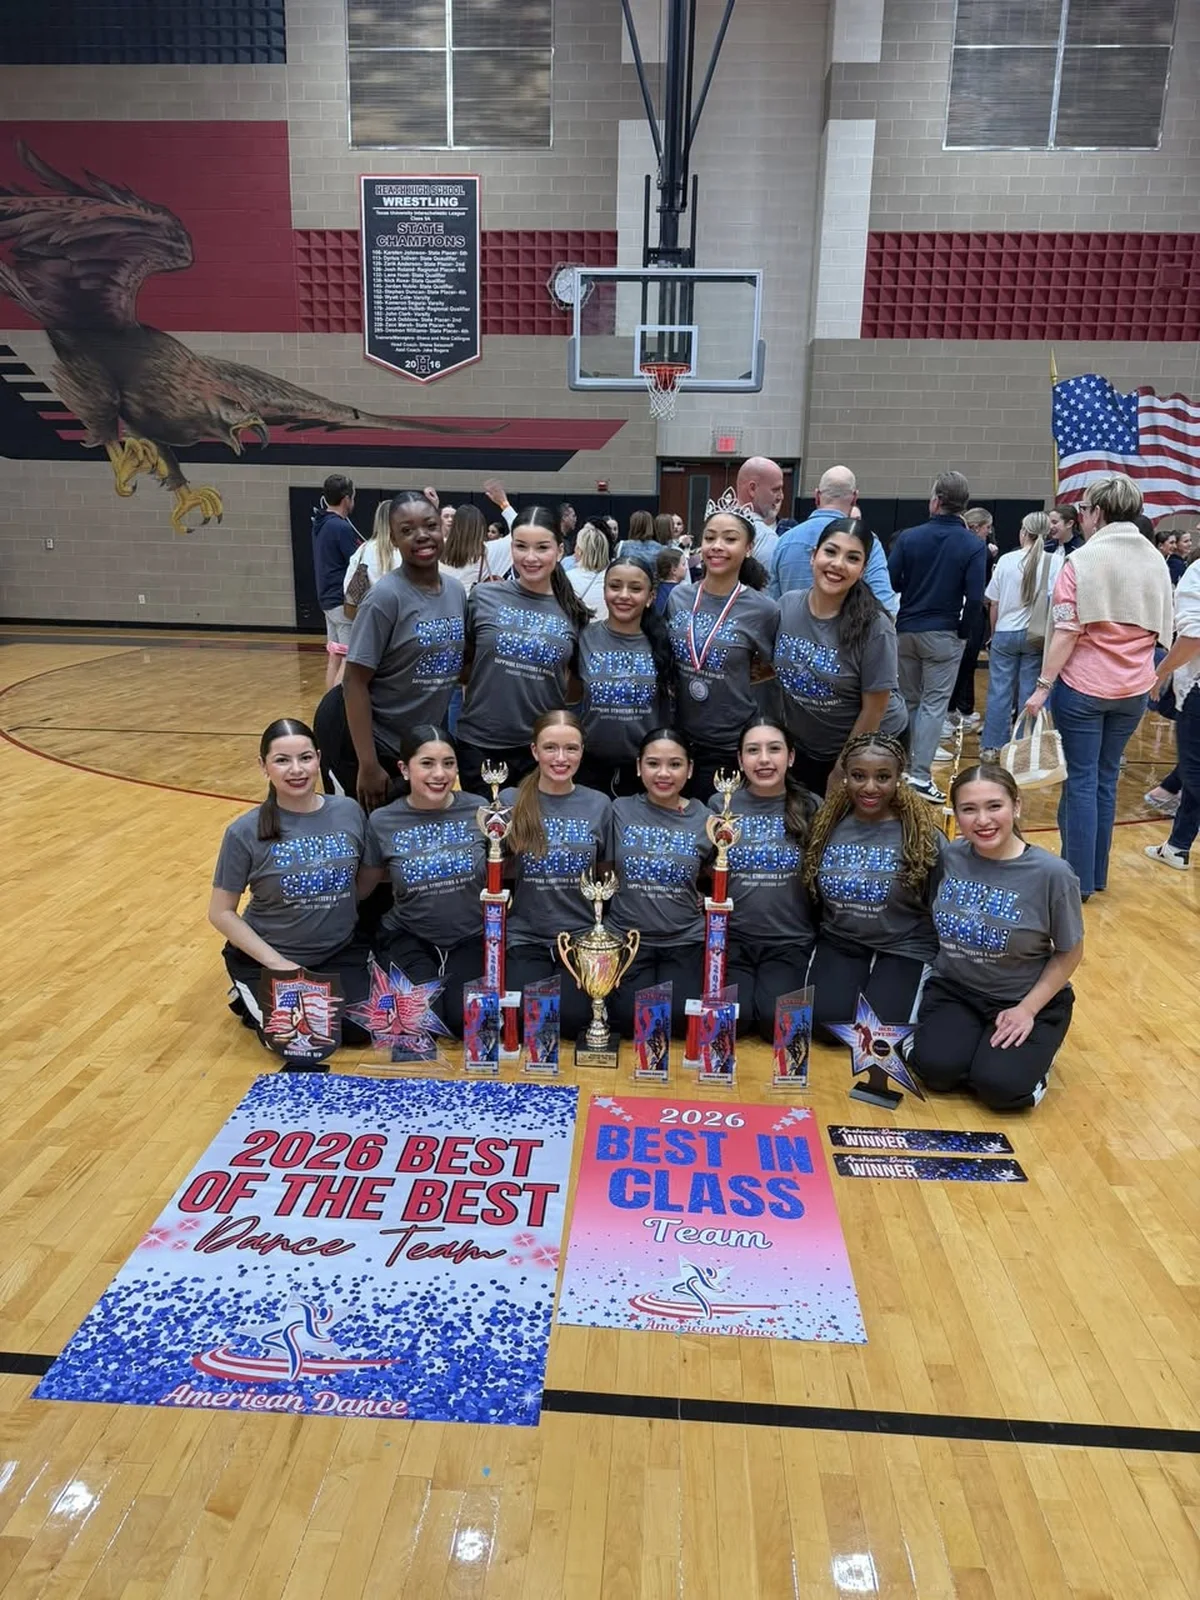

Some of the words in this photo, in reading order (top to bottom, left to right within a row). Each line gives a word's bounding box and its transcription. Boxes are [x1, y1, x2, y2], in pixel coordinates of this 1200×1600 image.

[375, 185, 407, 195] HEATH
[407, 185, 430, 195] HIGH
[430, 185, 465, 195] SCHOOL
[383, 197, 459, 207] WRESTLING
[376, 234, 466, 248] CHAMPIONS
[397, 222, 444, 235] STATE
[405, 361, 417, 369] 20
[429, 361, 441, 369] 16
[497, 605, 571, 641] STEAL
[495, 631, 566, 665] SHOW
[588, 650, 659, 677] STEAL
[775, 632, 842, 676] STEAL
[589, 680, 658, 707] SHOW
[271, 831, 357, 868] STEAL
[391, 820, 475, 856] STEAL
[622, 825, 699, 856] STEAL
[400, 848, 474, 885] SHOW
[623, 855, 695, 886] SHOW
[728, 845, 800, 871] SHOW
[820, 844, 900, 872] STEAL
[280, 864, 355, 898] SHOW
[820, 874, 892, 903] SHOW
[940, 876, 1023, 924] STEAL
[935, 910, 1011, 952] SHOW
[284, 1049, 312, 1057] RUNNER
[660, 1107, 746, 1128] 2026
[229, 1130, 388, 1172] 2026
[395, 1135, 544, 1177] BEST
[595, 1124, 728, 1168] BEST
[756, 1134, 815, 1174] IN
[842, 1133, 909, 1149] WINNER
[848, 1162, 919, 1178] WINNER
[178, 1171, 270, 1214] OF
[274, 1173, 396, 1221] THE
[400, 1179, 560, 1227] BEST
[608, 1167, 805, 1221] CLASS
[194, 1216, 356, 1256] Dance
[380, 1224, 507, 1268] Team
[643, 1217, 773, 1250] Team
[644, 1319, 721, 1335] American
[727, 1325, 779, 1338] Dance
[158, 1384, 306, 1412] American
[312, 1391, 409, 1417] Dance
